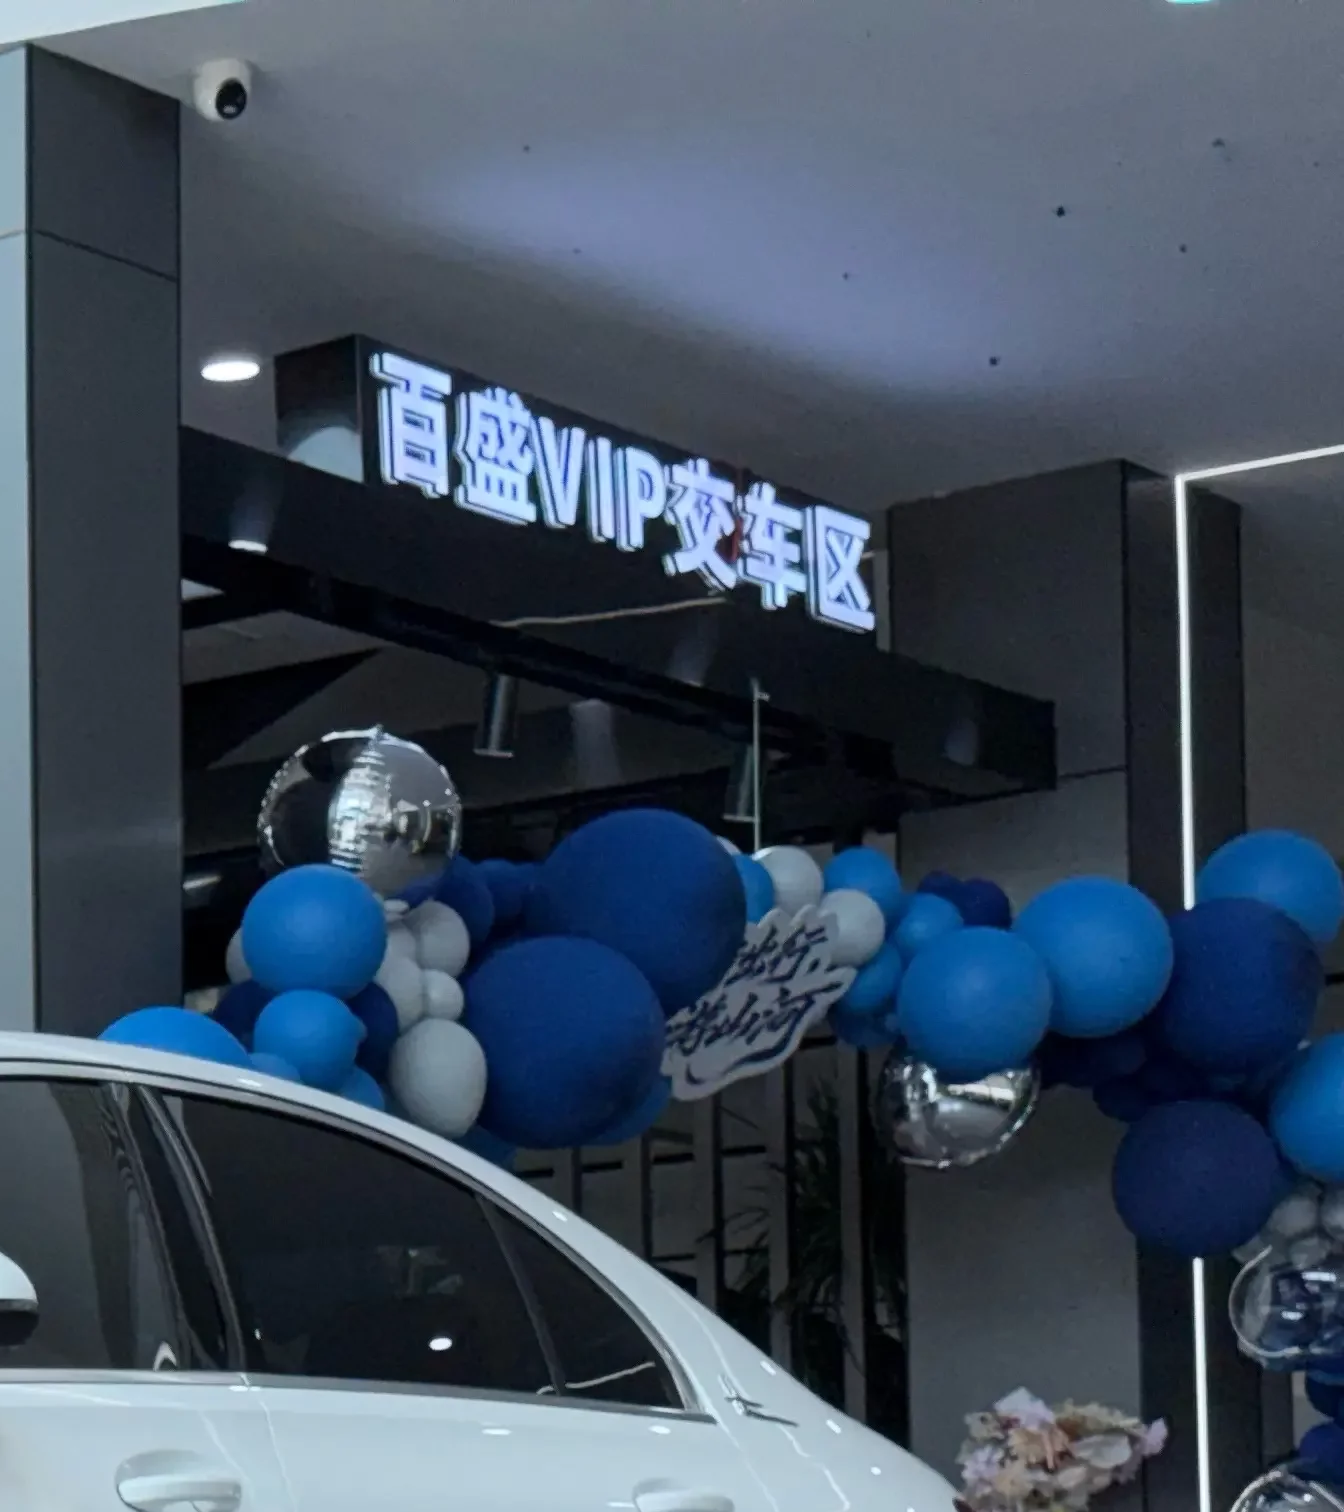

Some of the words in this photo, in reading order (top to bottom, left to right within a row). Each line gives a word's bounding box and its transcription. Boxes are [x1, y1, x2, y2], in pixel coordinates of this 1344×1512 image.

[369, 352, 875, 632] 百盛VIP交车区
